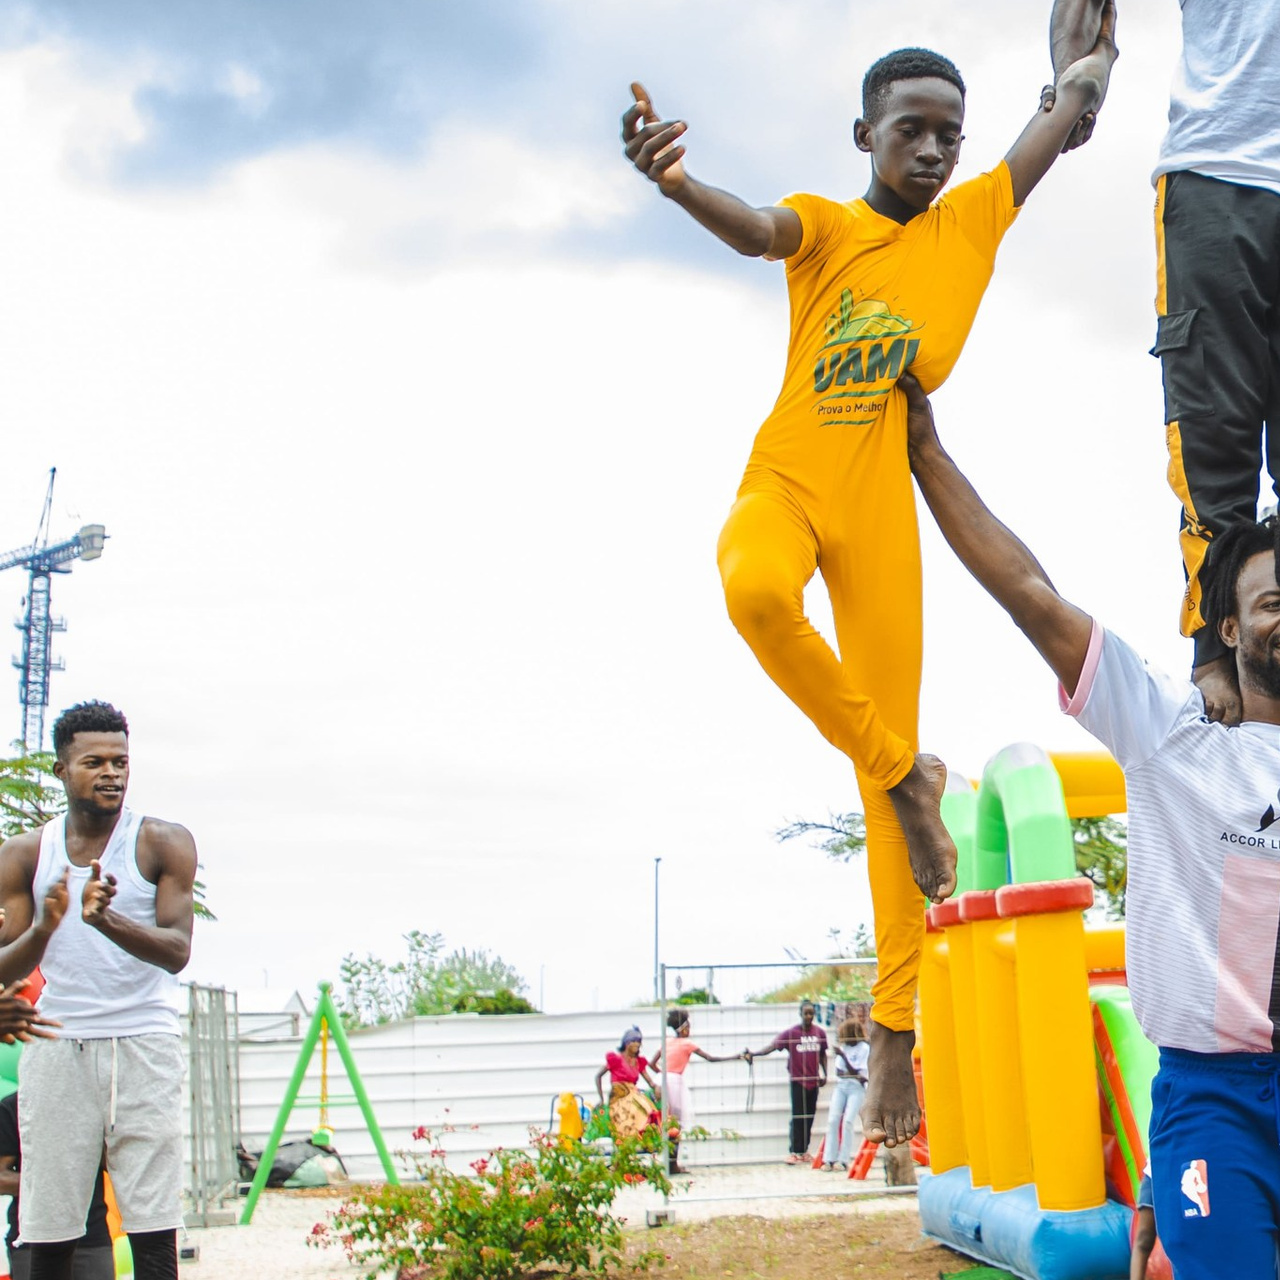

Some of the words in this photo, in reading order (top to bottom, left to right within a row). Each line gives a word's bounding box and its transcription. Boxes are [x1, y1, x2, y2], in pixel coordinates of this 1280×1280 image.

[817, 405, 843, 415] Prova
[1220, 832, 1265, 848] ACCOR
[1184, 1208, 1198, 1217] NBA
